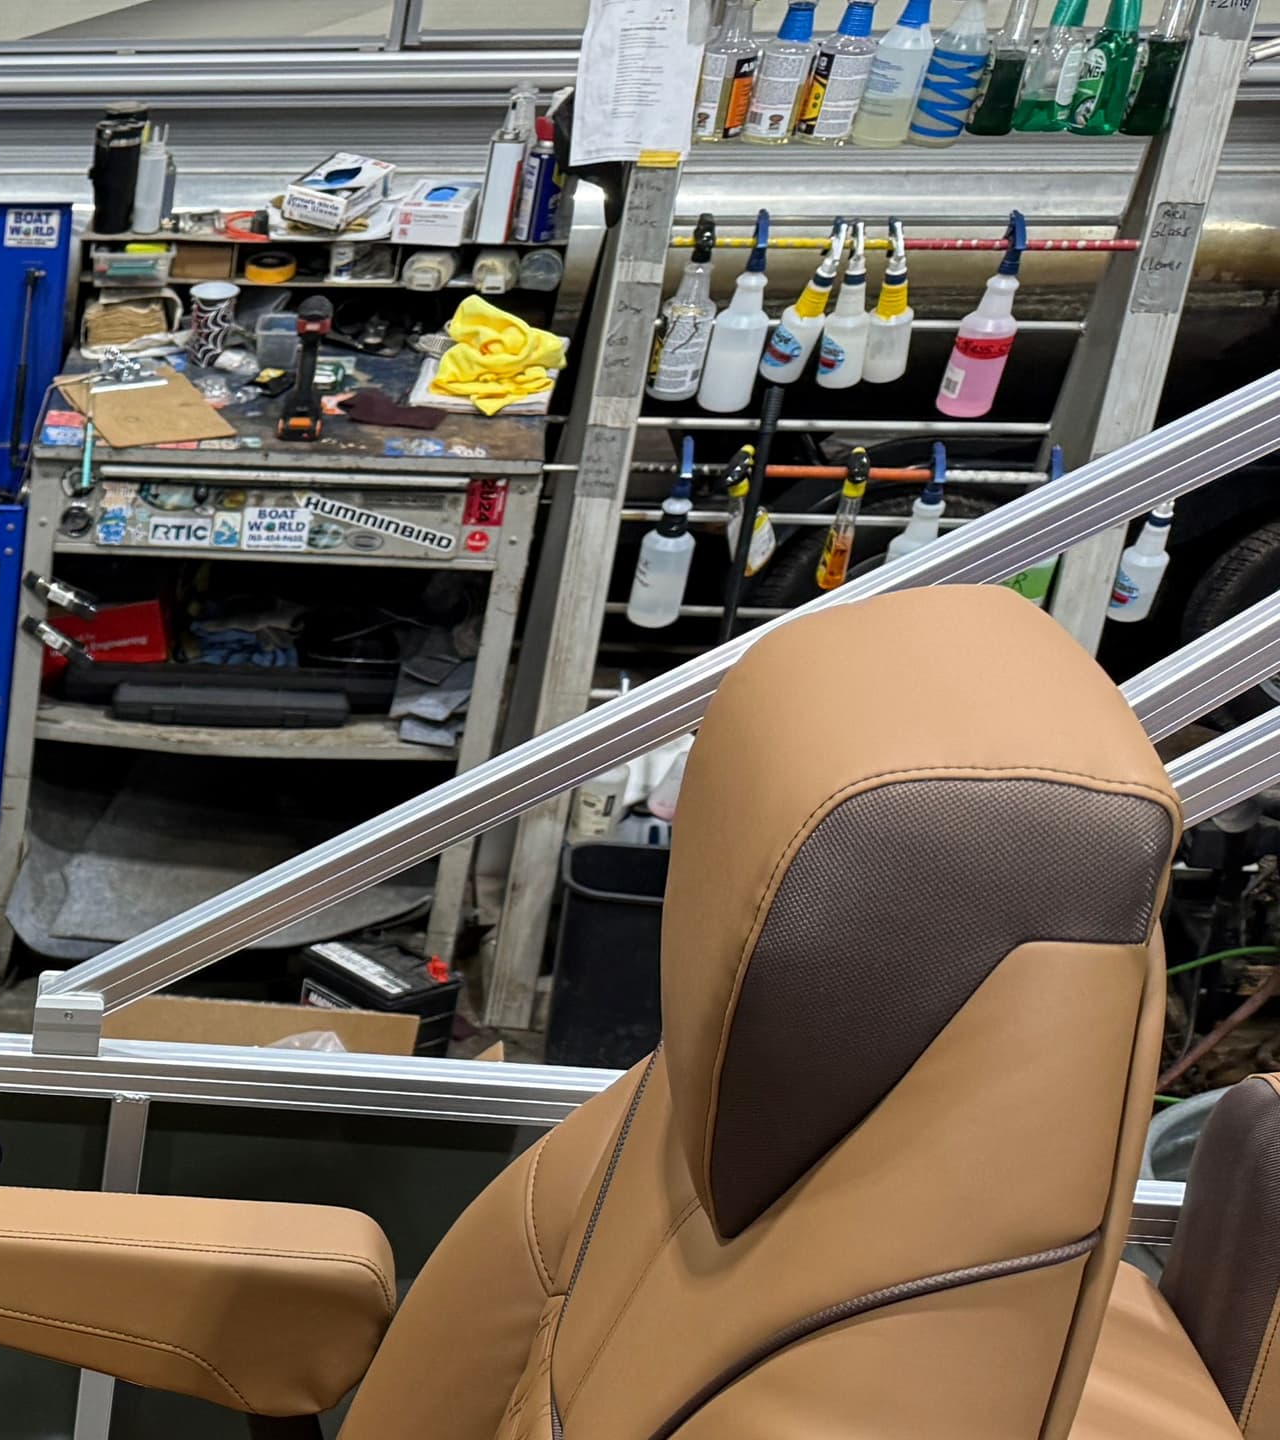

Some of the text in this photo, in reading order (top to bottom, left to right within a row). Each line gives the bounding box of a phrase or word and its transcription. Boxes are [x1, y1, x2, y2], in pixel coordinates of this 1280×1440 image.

[14, 211, 52, 224] BOAT
[258, 509, 297, 520] BOAT
[304, 495, 454, 551] HUMMINBIRD
[151, 524, 209, 542] RTIC
